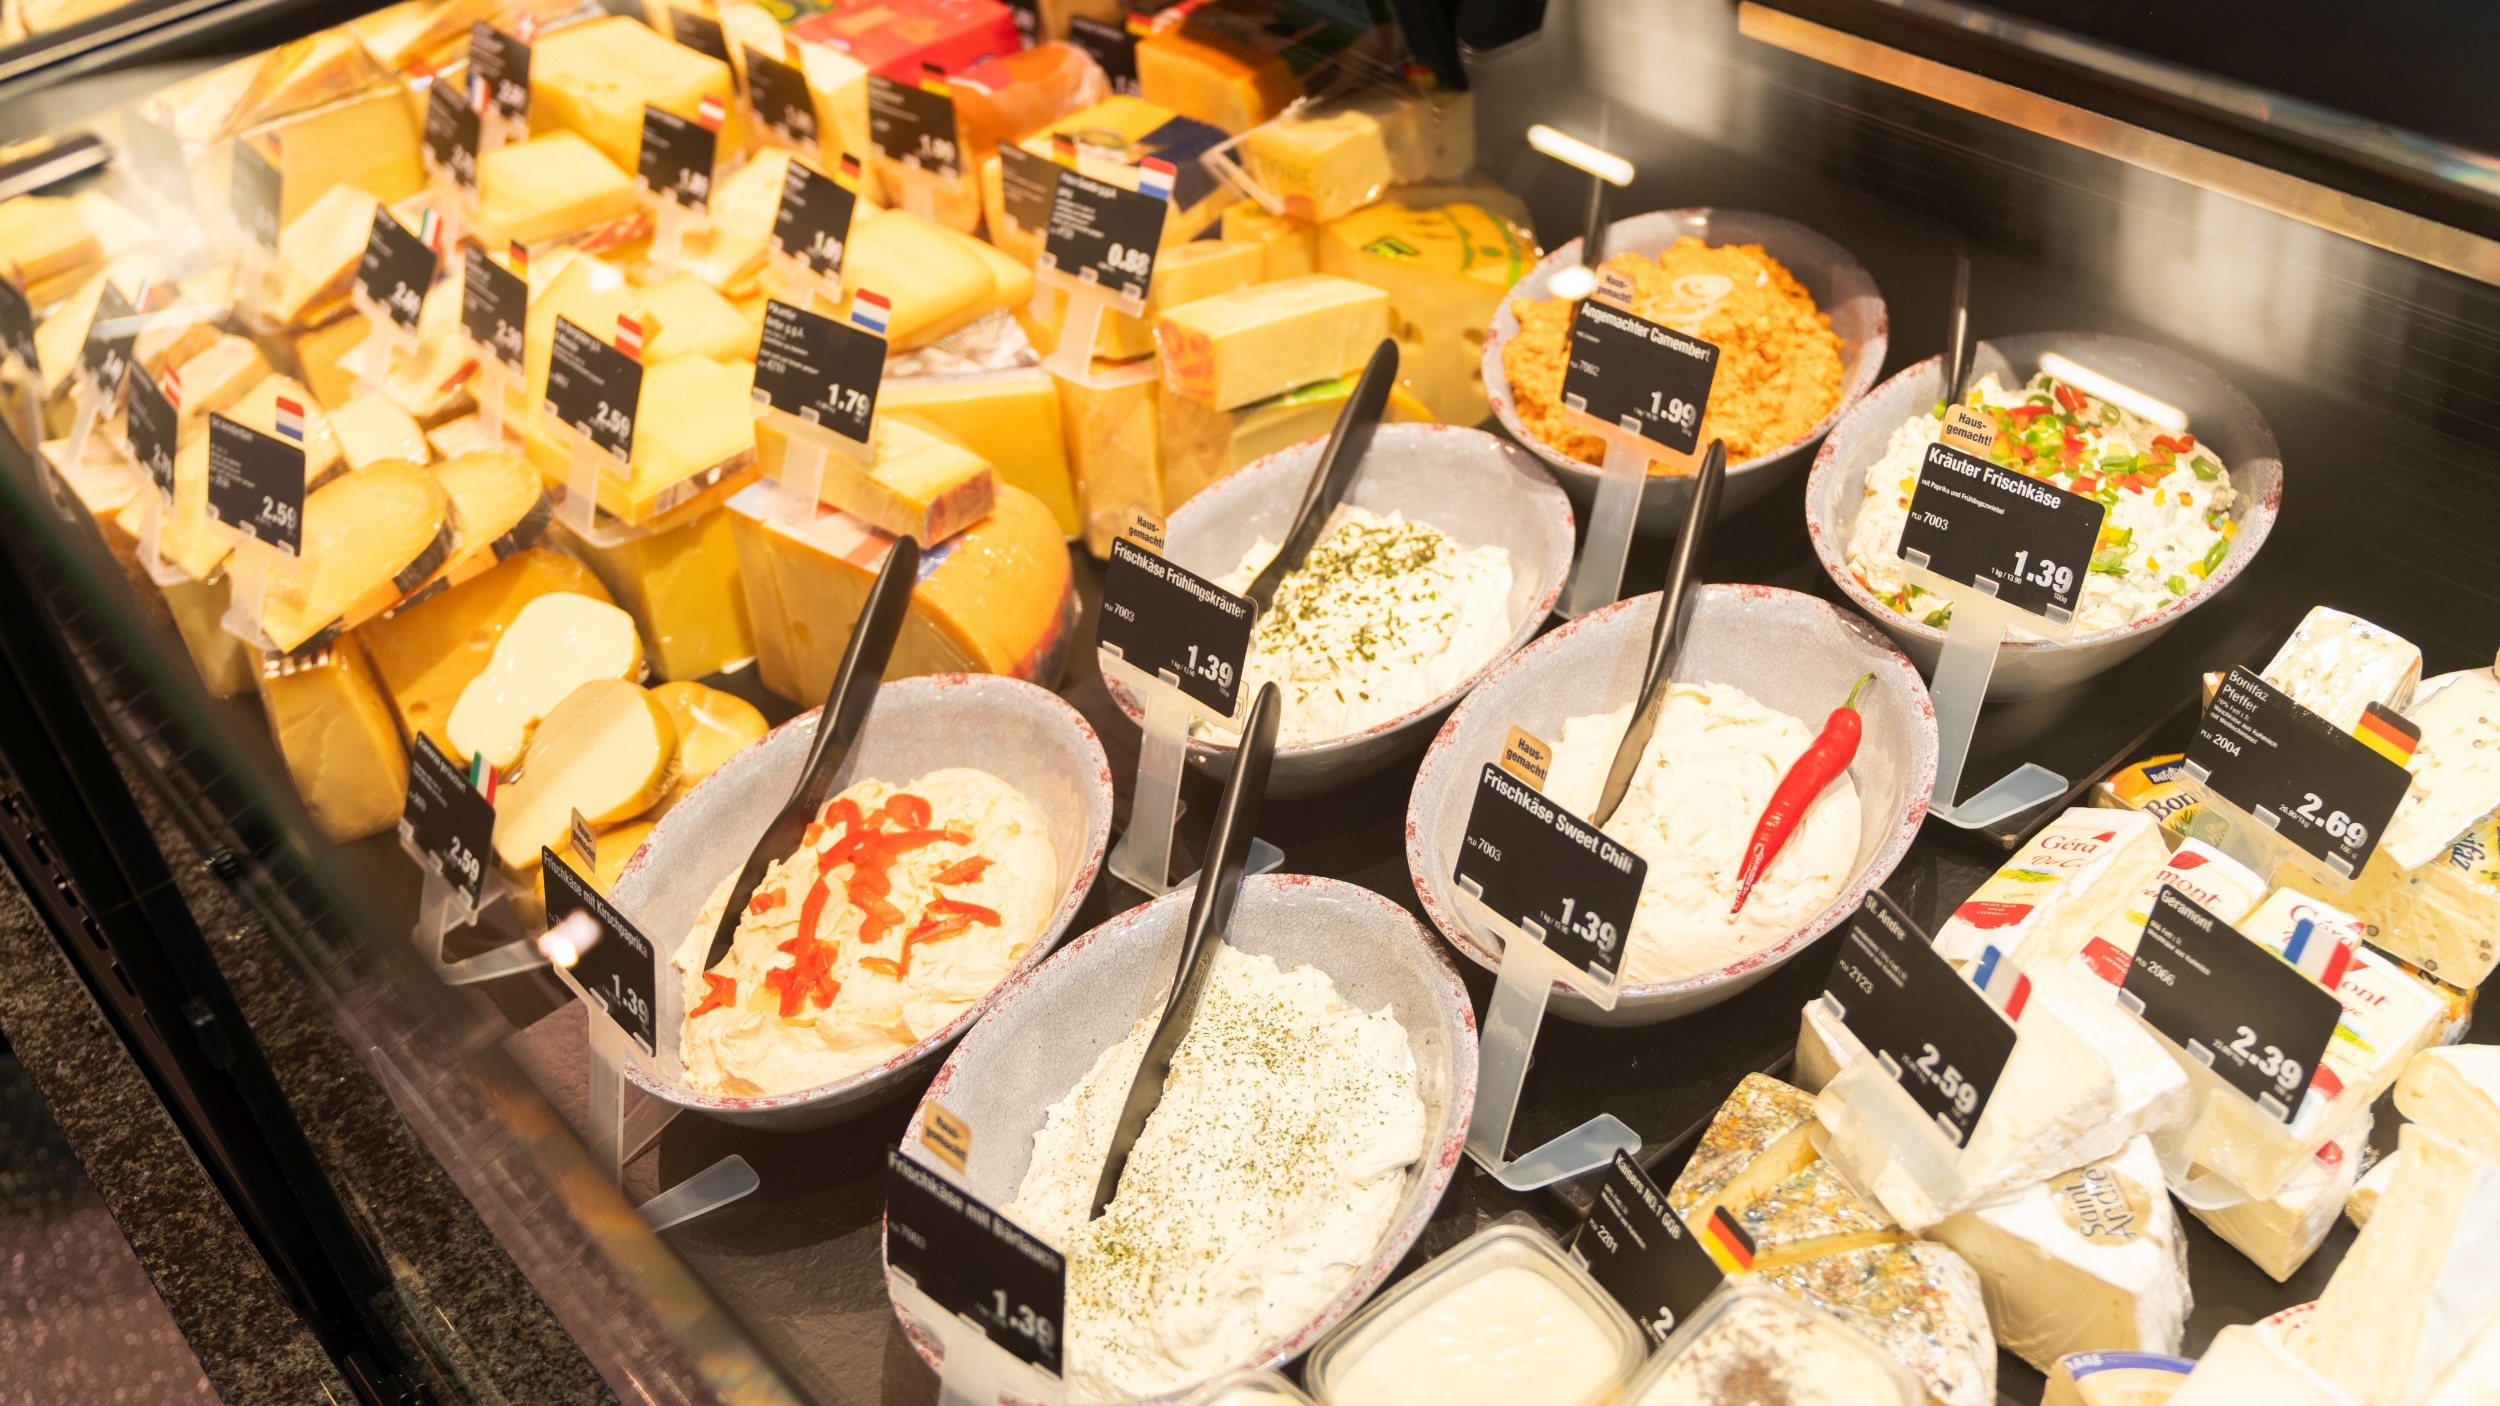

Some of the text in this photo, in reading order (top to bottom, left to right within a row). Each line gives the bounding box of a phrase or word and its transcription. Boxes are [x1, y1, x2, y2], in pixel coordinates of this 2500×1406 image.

[1107, 243, 1151, 276] 0.88
[1606, 274, 1628, 288] Haus-
[1581, 301, 1712, 363] Angemachter Camembert
[828, 383, 871, 418] 1.79
[1651, 391, 1698, 429] 1.99
[596, 400, 631, 439] 2.59
[1946, 423, 1994, 447] gemacht!
[1958, 412, 1987, 430] Haus-
[1928, 447, 2061, 510] Kräuter Frischkäse
[1931, 481, 1951, 496] Paprika
[1950, 490, 1961, 499] und
[262, 495, 298, 530] 2.59
[1137, 515, 1159, 533] Haus-
[1911, 511, 1949, 531] PLU 7003
[1128, 527, 1165, 549] gemacht!
[1114, 541, 1246, 620] Frischkäse Frühlingskräuter
[2014, 550, 2074, 595] 1.39
[1114, 603, 1135, 623] 7003
[1188, 644, 1234, 689] 1.39
[2222, 684, 2259, 713] Pfeffer
[2229, 670, 2269, 702] Bonifaz
[2217, 697, 2229, 709] 70%
[2229, 705, 2241, 716] Fett
[2201, 729, 2241, 757] PLU 2004
[2214, 704, 2278, 748] Weichkäse aus Kuhmilch
[1506, 748, 1548, 781] gemacht!
[1517, 738, 1544, 761] Haus-
[577, 820, 593, 844] Haus-
[1483, 768, 1634, 875] Frischkäse Sweet Chili
[2279, 804, 2310, 828] 26.90/1kg
[2296, 792, 2369, 850] 2.69
[450, 836, 481, 882] 2.59
[1467, 836, 1502, 862] PLU 7003
[2041, 834, 2098, 854] Géra
[543, 851, 648, 959] Frischkäse mit Kirschpaprika
[2156, 870, 2222, 910] mont
[1562, 897, 1618, 952] 1.39
[1865, 895, 1906, 941] St. Andre
[2161, 889, 2214, 933] Geramont
[1839, 959, 1875, 994] PLU 2123
[2147, 961, 2176, 986] 2066
[612, 973, 650, 1026] 1.39
[2229, 1025, 2304, 1090] 2.39
[1916, 1043, 1979, 1115] 2.59
[1616, 1153, 1645, 1194] Kaisers
[888, 1152, 1060, 1273] Frischkäse mit Bärlauch
[2065, 1183, 2102, 1237] Saint
[2079, 1167, 2137, 1238] André
[1588, 1218, 1619, 1254] PLU 2201
[993, 1289, 1057, 1349] 1.39
